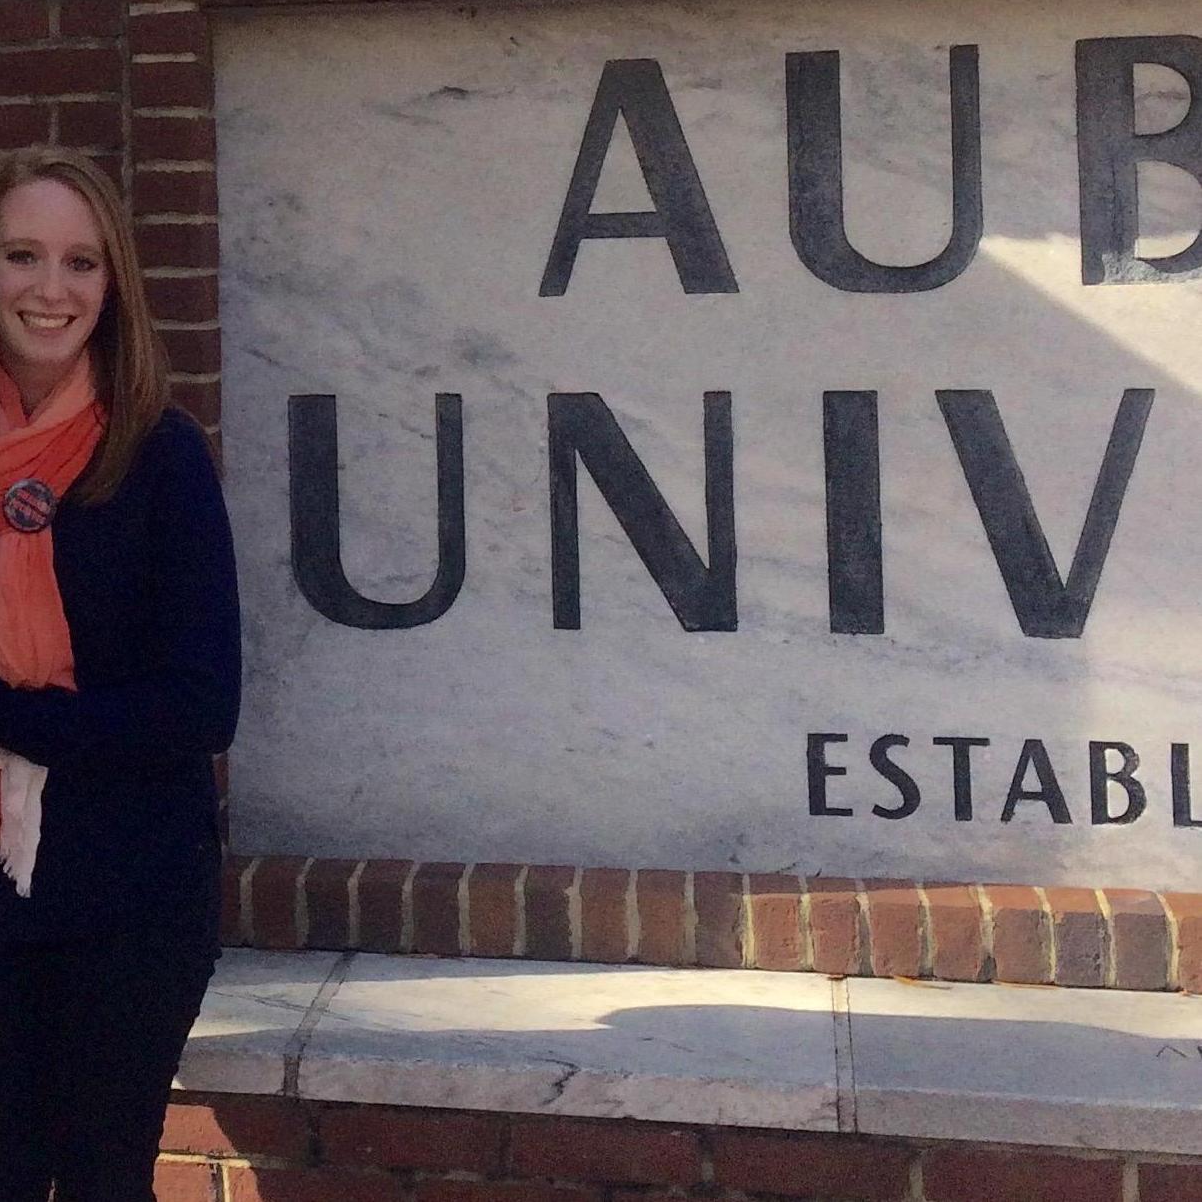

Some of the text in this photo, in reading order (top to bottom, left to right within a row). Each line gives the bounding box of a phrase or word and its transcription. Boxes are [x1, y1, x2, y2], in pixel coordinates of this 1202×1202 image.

[538, 34, 1202, 298] AUB
[287, 387, 1156, 639] UNIV
[806, 732, 1202, 828] ESTABL
